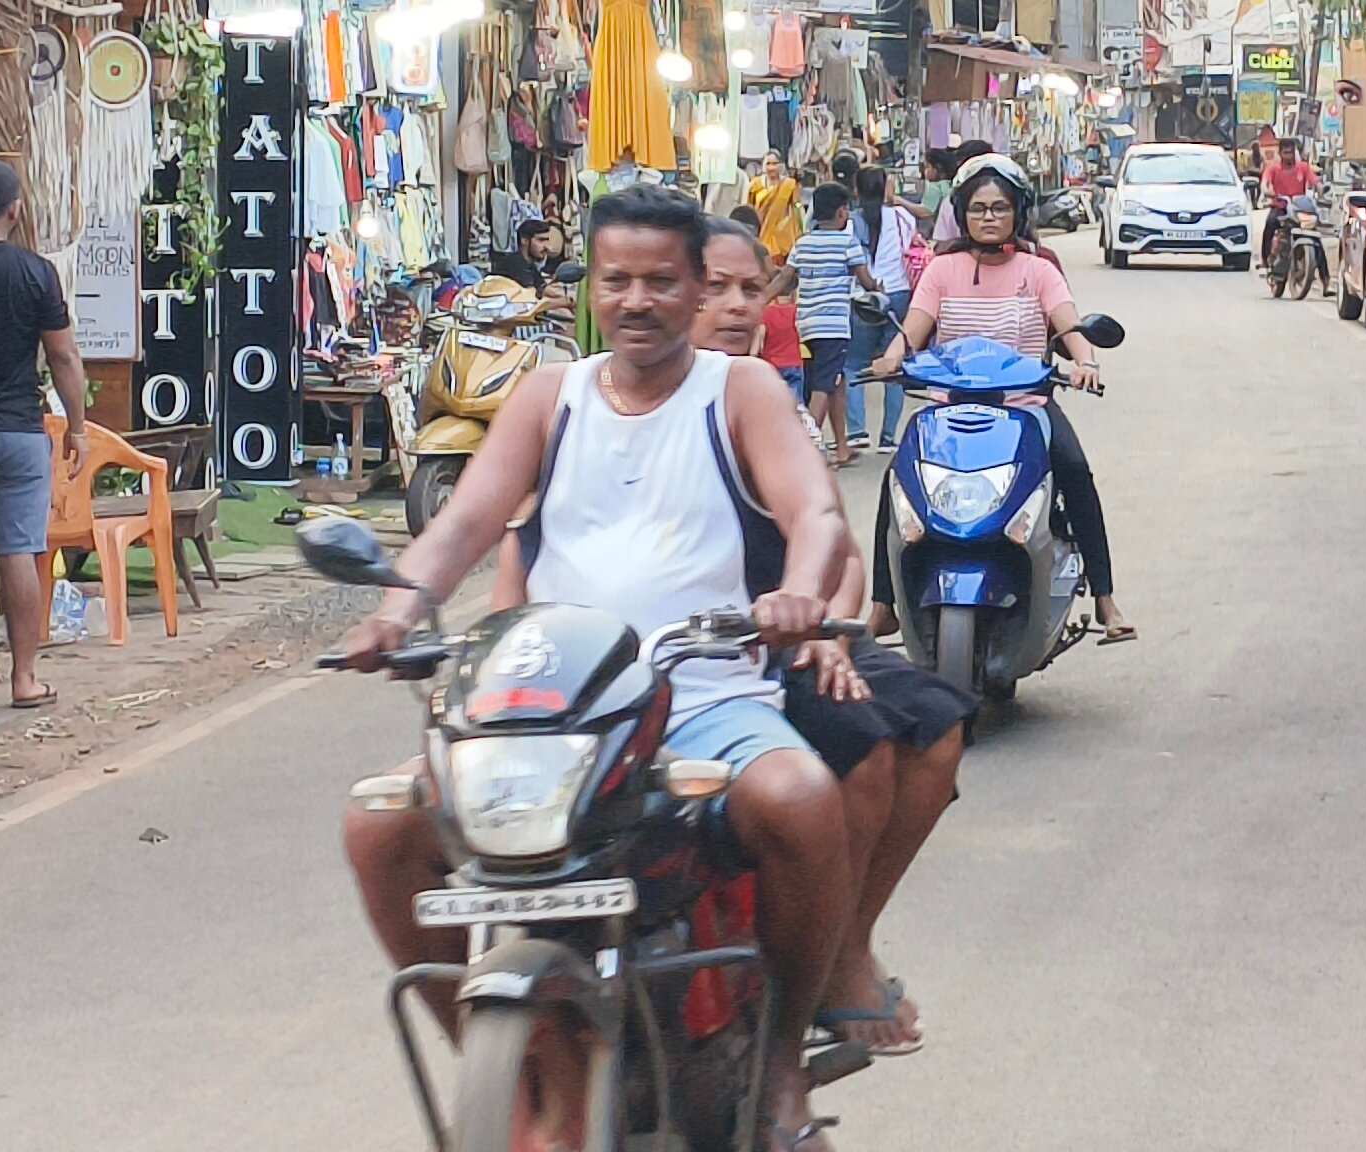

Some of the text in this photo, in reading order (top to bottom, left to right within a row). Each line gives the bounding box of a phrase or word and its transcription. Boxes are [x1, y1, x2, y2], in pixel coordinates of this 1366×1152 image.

[1247, 52, 1296, 70] Cuba
[77, 243, 135, 265] MOON
[231, 38, 289, 470] TATTOO
